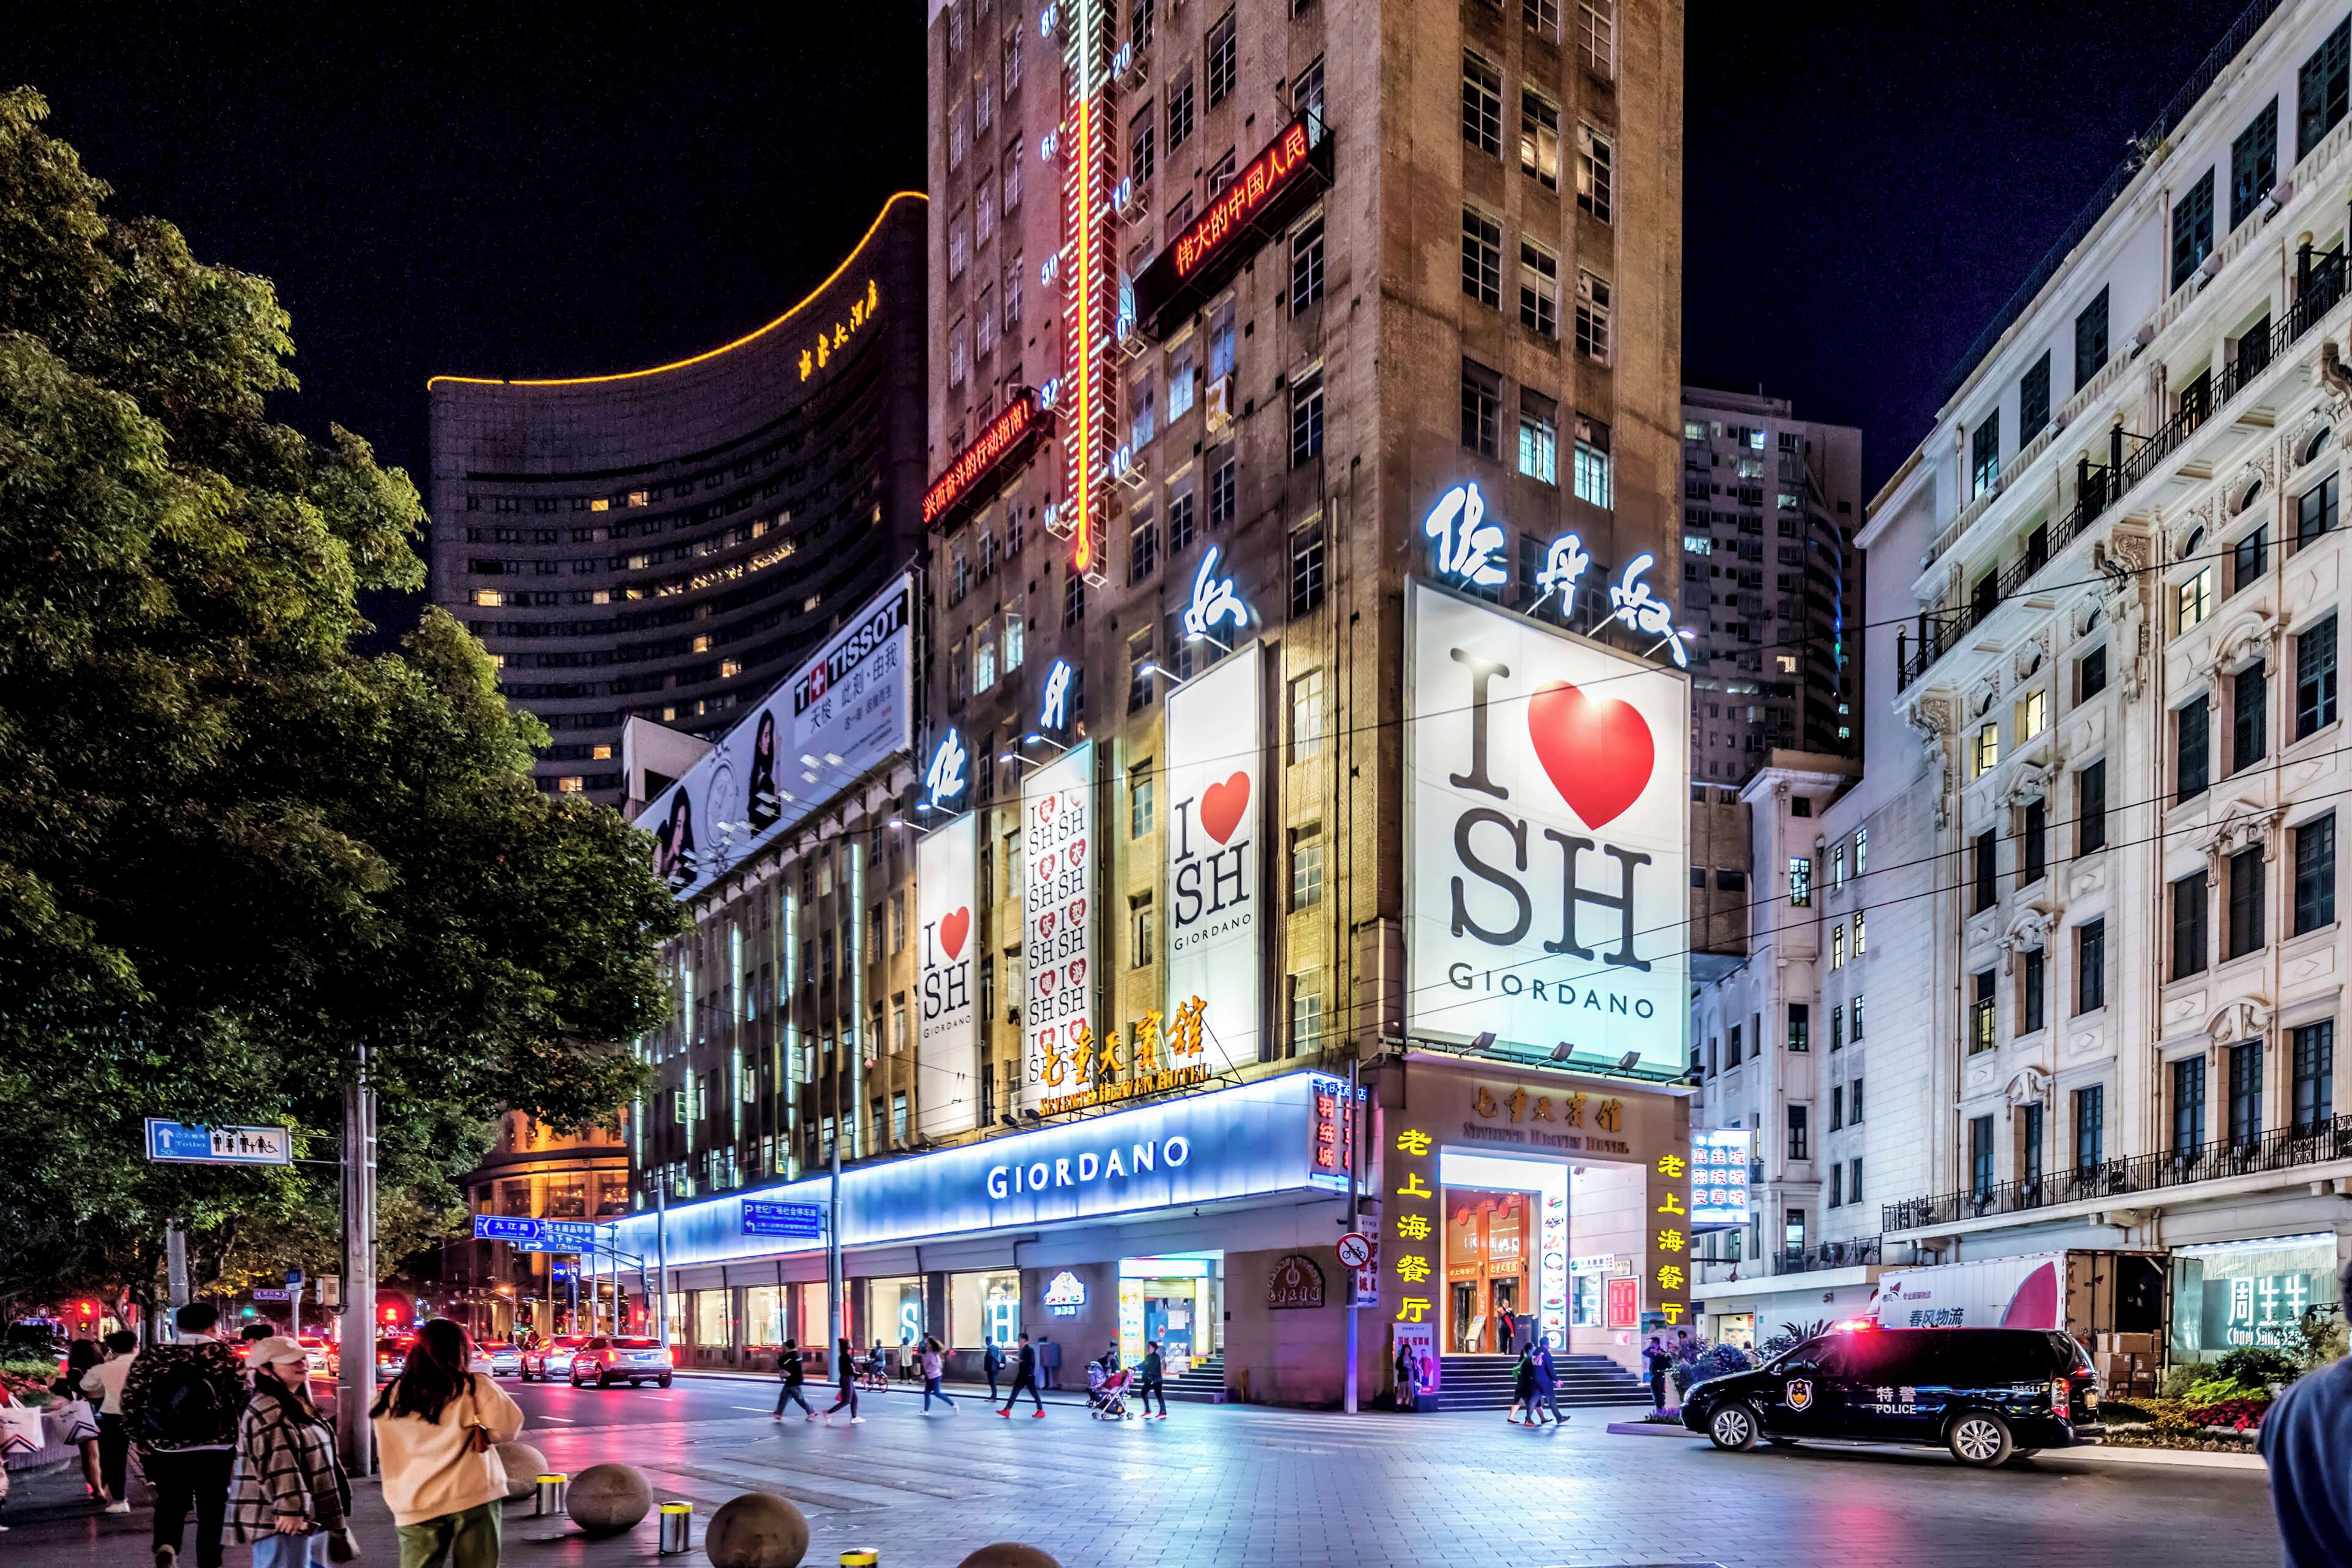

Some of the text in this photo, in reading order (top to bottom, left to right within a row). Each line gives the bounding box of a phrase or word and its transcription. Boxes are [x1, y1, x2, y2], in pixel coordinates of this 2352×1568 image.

[1041, 1, 1058, 37] 86
[1112, 42, 1131, 82] 20
[1041, 127, 1058, 160] 68
[1113, 176, 1131, 211] 10
[1177, 124, 1305, 275] 伟大的中国人民
[1041, 254, 1058, 286] 50
[1117, 315, 1126, 341] 0
[1042, 378, 1058, 410] 32
[1112, 445, 1129, 478] 10
[829, 595, 903, 681] TISSOT
[1450, 648, 1510, 800] I
[1029, 823, 1054, 857] SH
[1058, 806, 1085, 842] SH
[1175, 797, 1194, 864] I
[1029, 881, 1054, 914] SH
[1058, 866, 1085, 901] SH
[1175, 840, 1250, 929] SH
[1450, 807, 1652, 973] SH
[924, 921, 935, 971] I
[1058, 925, 1085, 959] SH
[1174, 914, 1251, 950] GIORDANO
[1030, 939, 1054, 970] SH
[924, 959, 970, 1021] SH
[1058, 986, 1085, 1017] SH
[1449, 963, 1654, 1019] GIORDANO
[923, 1015, 971, 1038] GIORDANO
[1030, 997, 1054, 1027] SH
[1039, 1063, 1210, 1116] SEVENTH HEAVEN HOTEL
[1317, 1095, 1335, 1168] 羽绒城
[987, 1136, 1191, 1199] GIORDANO
[495, 1222, 529, 1231] 九江路
[1396, 1129, 1432, 1323] 老上海餐厅
[1657, 1154, 1686, 1325] 老上海餐厅
[1909, 1307, 1964, 1328] 春风物流
[2227, 1274, 2308, 1327] 周生生
[1876, 1404, 1917, 1414] POLICE
[1877, 1385, 1916, 1403] 特警
